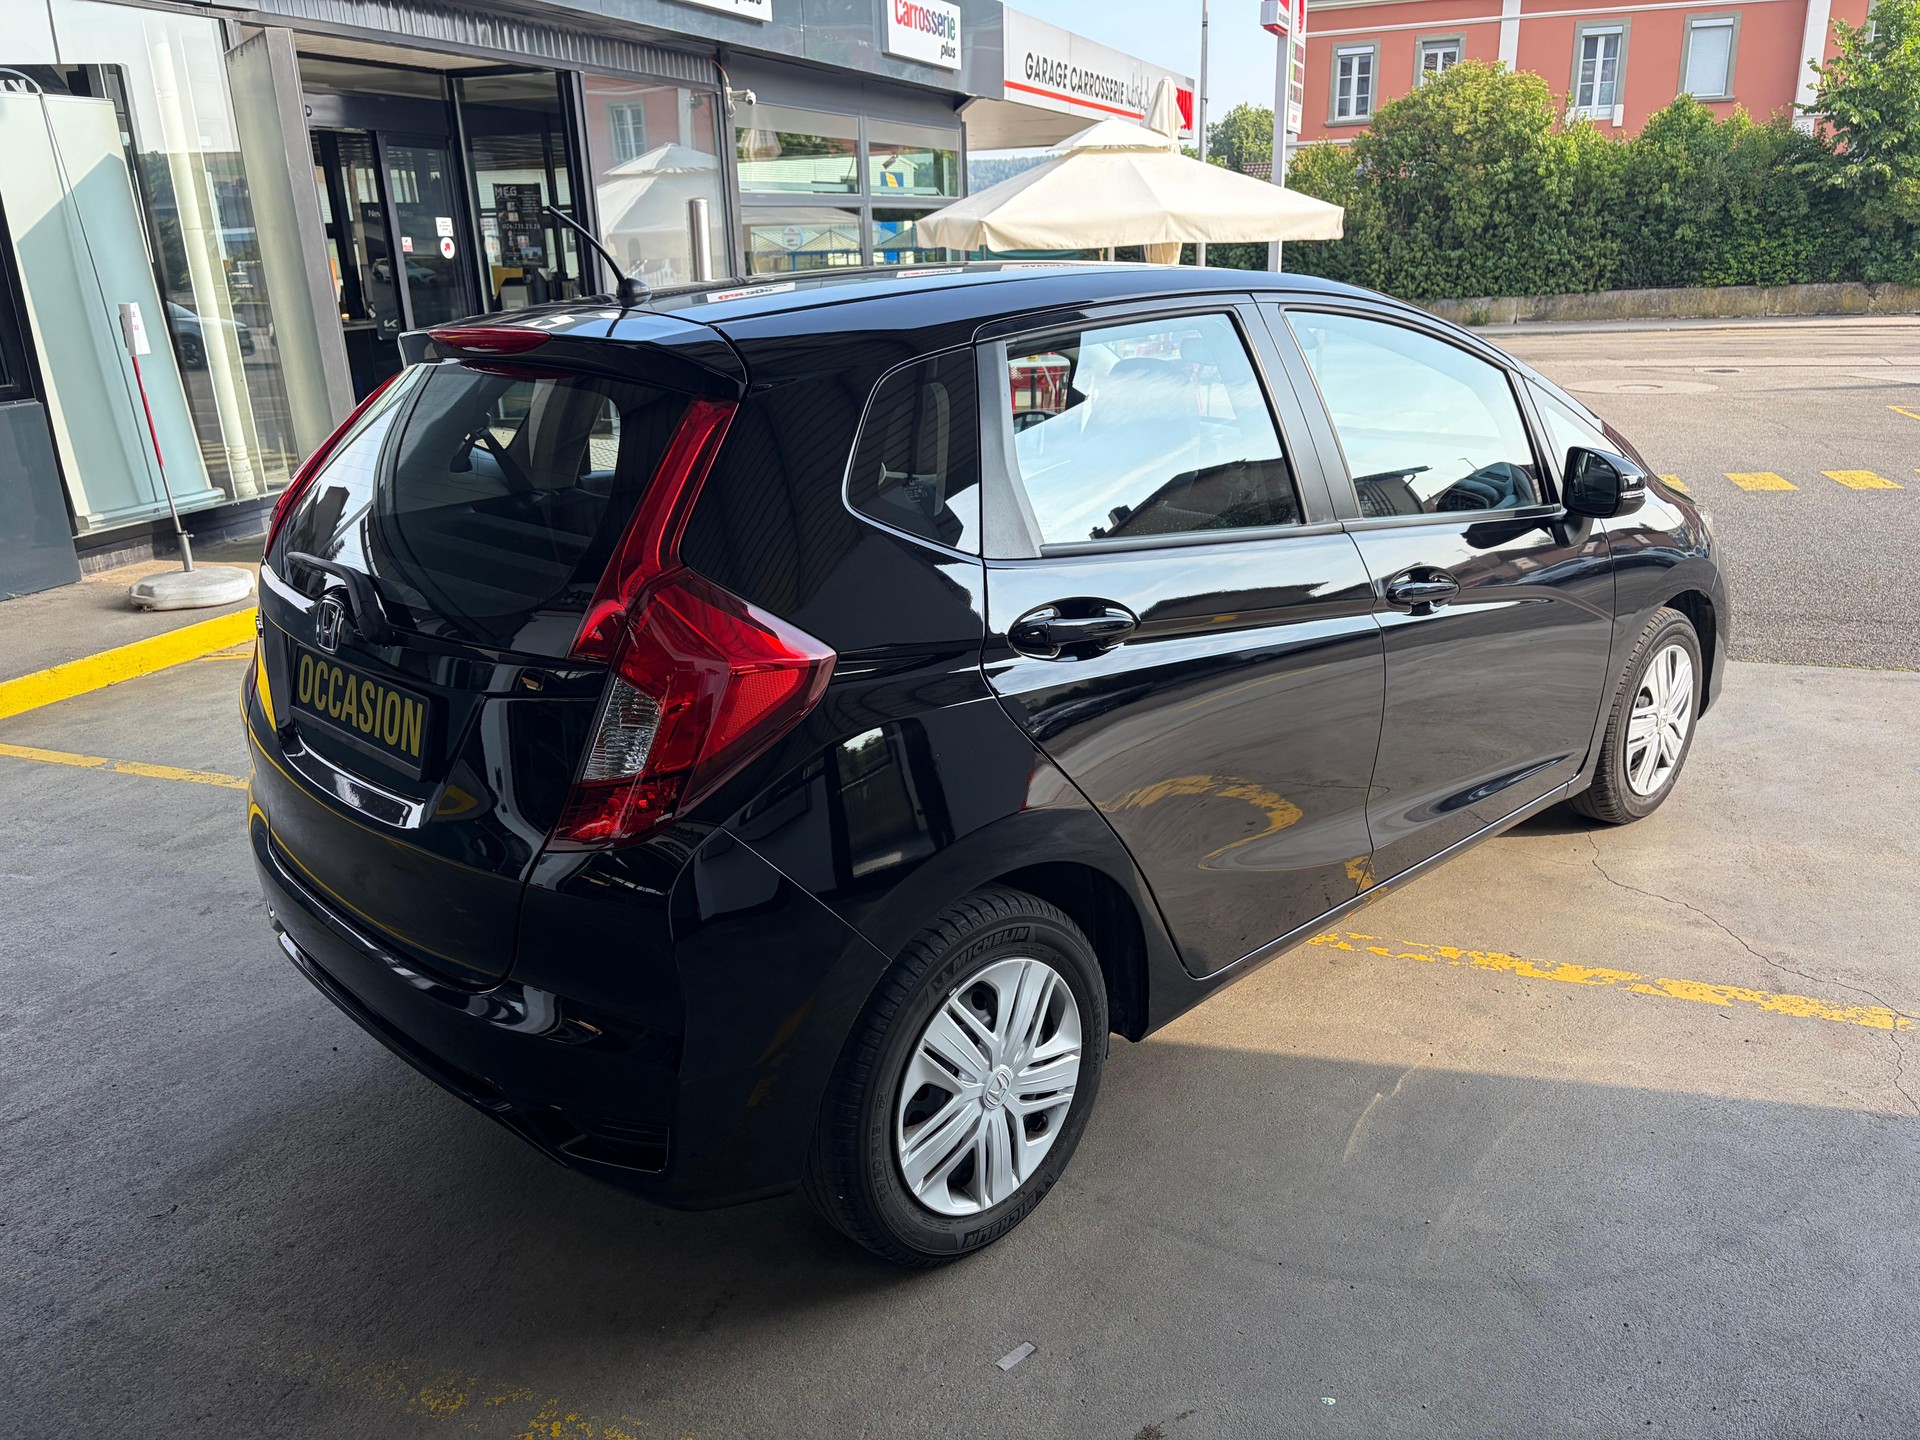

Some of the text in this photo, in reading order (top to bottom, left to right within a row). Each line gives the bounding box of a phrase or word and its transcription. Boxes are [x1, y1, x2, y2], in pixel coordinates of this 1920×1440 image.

[894, 0, 956, 41] Carrosserie
[940, 41, 956, 59] plus
[1025, 52, 1068, 89] GARAGE
[1070, 67, 1124, 105] CARROSSERIE
[299, 654, 423, 758] OCCASION
[953, 926, 1030, 972] MICHELIN
[963, 1191, 1036, 1248] MICHELIN
